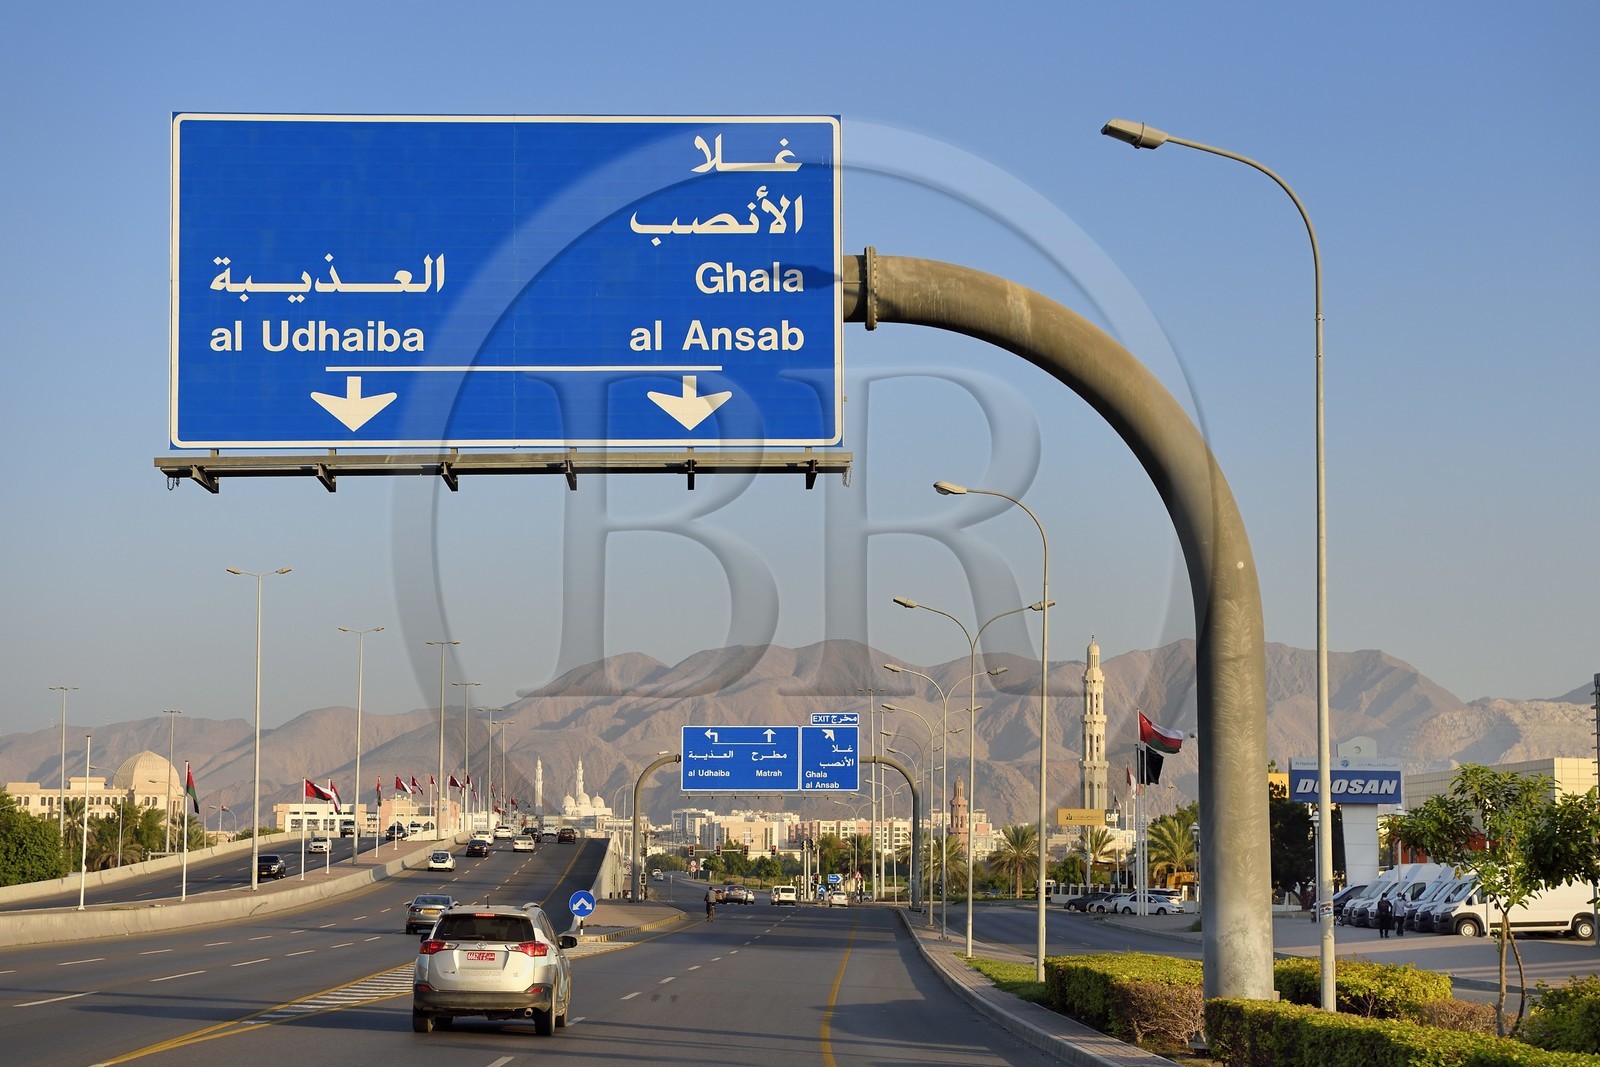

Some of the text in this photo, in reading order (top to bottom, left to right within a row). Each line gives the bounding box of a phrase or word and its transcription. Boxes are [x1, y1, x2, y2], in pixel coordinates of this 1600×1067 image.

[691, 133, 802, 173] غلا
[630, 185, 803, 246] الأنصب
[210, 253, 446, 303] العذيبة
[695, 262, 804, 294] Ghala
[210, 320, 425, 352] al Udhaiba
[630, 320, 804, 351] al Ansab
[813, 715, 830, 723] EXIT
[831, 714, 858, 723] مخرج
[688, 750, 734, 760] العذيبة
[751, 751, 788, 761] مطرح
[819, 757, 854, 768] الأنصب
[698, 769, 731, 777] Udhaiba
[755, 769, 783, 777] Matrah
[805, 770, 828, 778] Ghala
